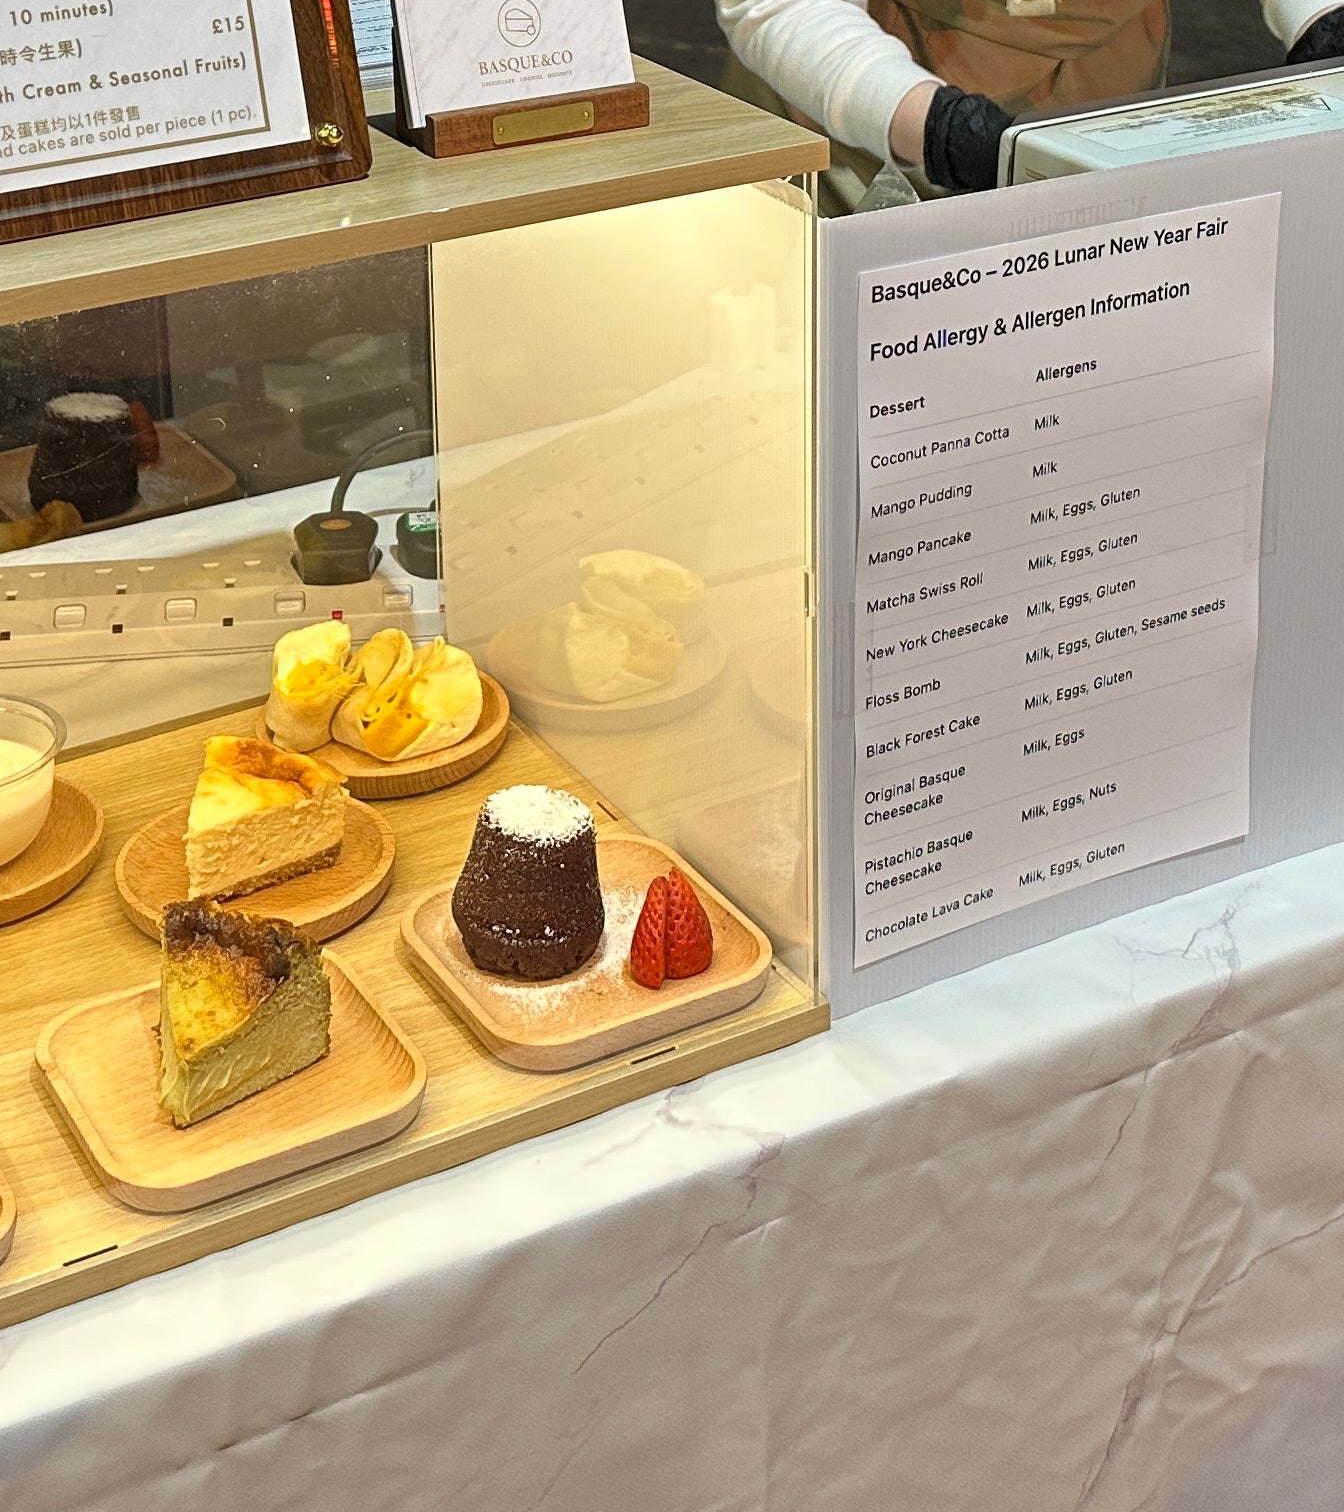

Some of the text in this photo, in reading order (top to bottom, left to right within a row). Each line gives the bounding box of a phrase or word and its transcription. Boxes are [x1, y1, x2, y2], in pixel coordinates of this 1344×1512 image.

[9, 8, 32, 27] 10
[212, 15, 245, 34] £15
[22, 81, 82, 100] Cream
[89, 73, 103, 90] &
[109, 59, 188, 87] Seasonal
[194, 50, 246, 74] Fruits)
[479, 50, 573, 75] BASQUE&CO
[18, 137, 66, 155] cakes
[69, 133, 95, 147] are
[98, 123, 131, 142] sold
[135, 122, 160, 138] per
[164, 115, 206, 134] piece
[211, 109, 223, 126] (1
[871, 268, 981, 304] Basque&Co
[1002, 251, 1049, 278] 2026
[1054, 243, 1106, 267] Lunar
[1110, 235, 1149, 255] New
[1153, 227, 1192, 247] Year
[1196, 216, 1229, 239] Fair
[870, 281, 1189, 361] Food Allergy & Allergen Information
[1035, 360, 1097, 383] Allergens
[869, 396, 925, 419] Dessert
[1030, 488, 1140, 525] Milk, Eggs, Gluten
[866, 613, 1008, 662] New York Cheesecake
[1025, 598, 1225, 664] Milk, Eggs, Gluten, Sesame seeds
[1021, 782, 1117, 822] Milk, Eggs, Nuts
